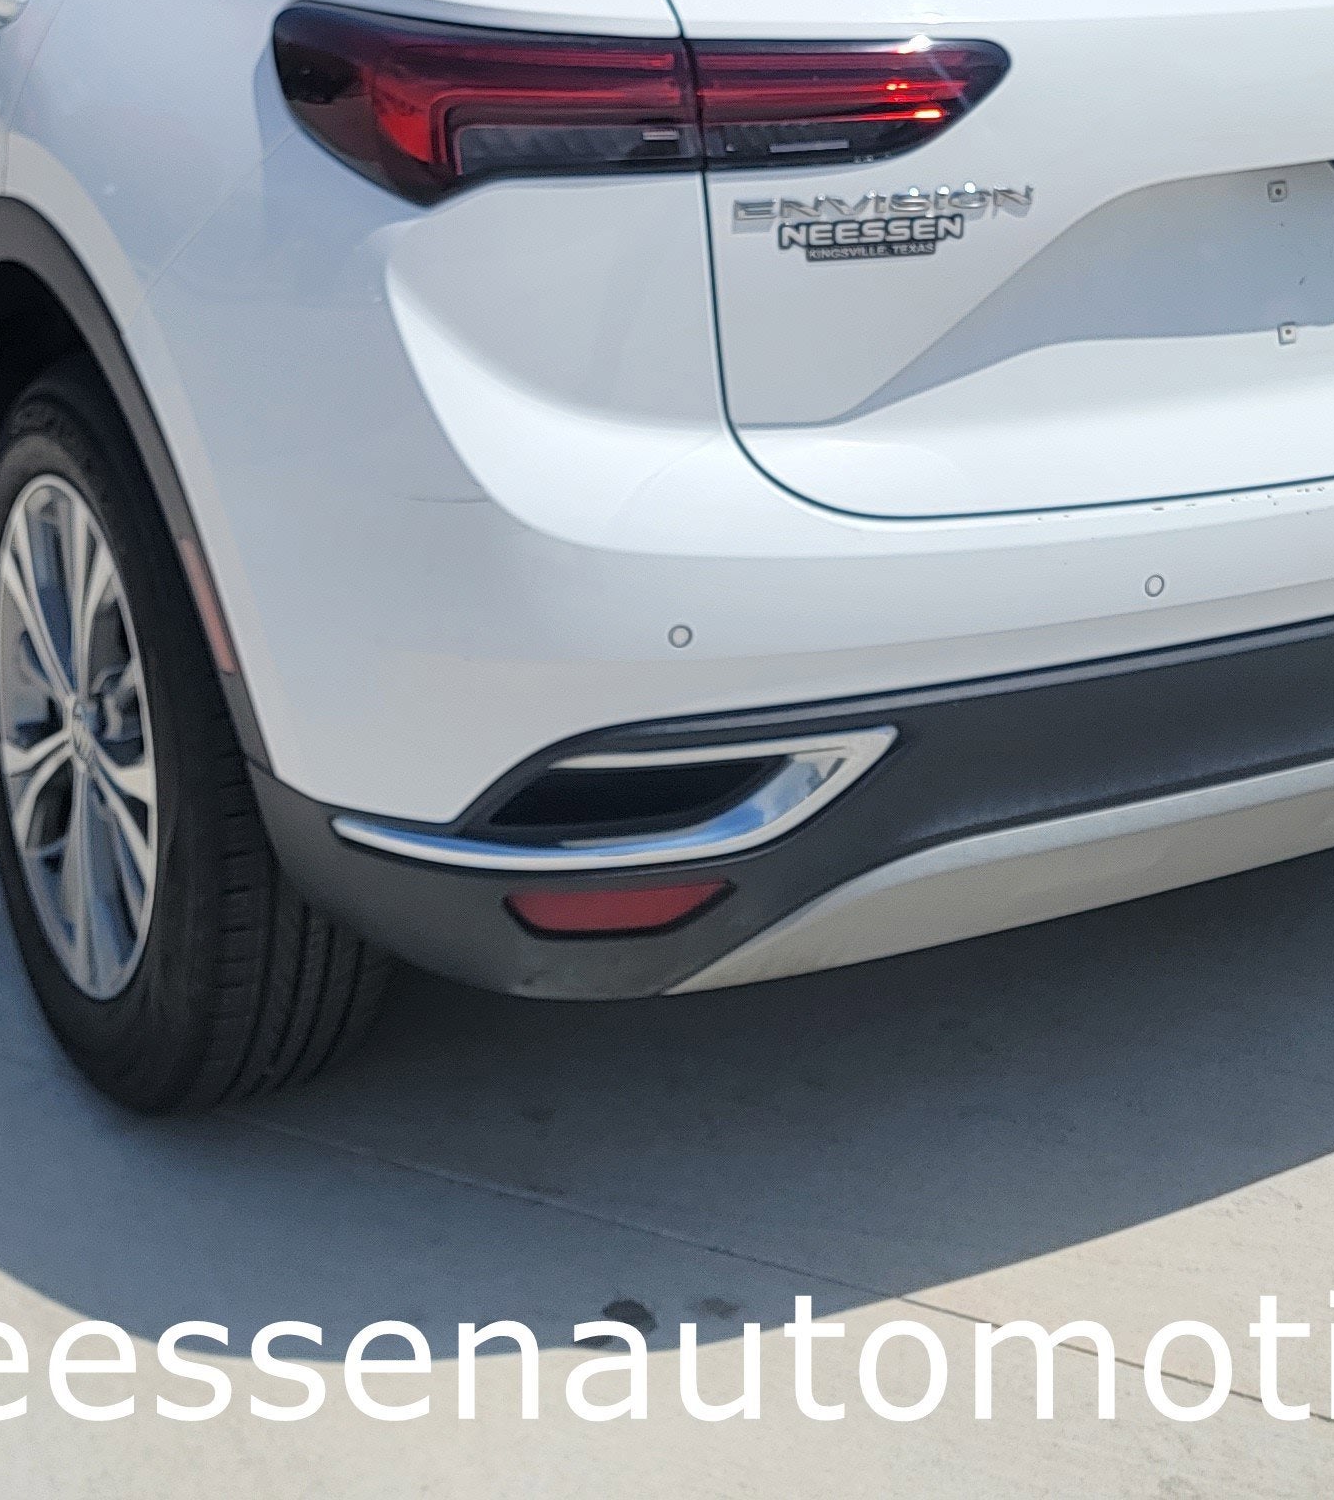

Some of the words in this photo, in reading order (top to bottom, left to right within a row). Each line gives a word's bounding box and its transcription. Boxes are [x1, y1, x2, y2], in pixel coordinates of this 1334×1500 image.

[733, 184, 1034, 221] ENVISION
[780, 215, 964, 248] NEESSEN
[892, 242, 935, 255] TEXAS
